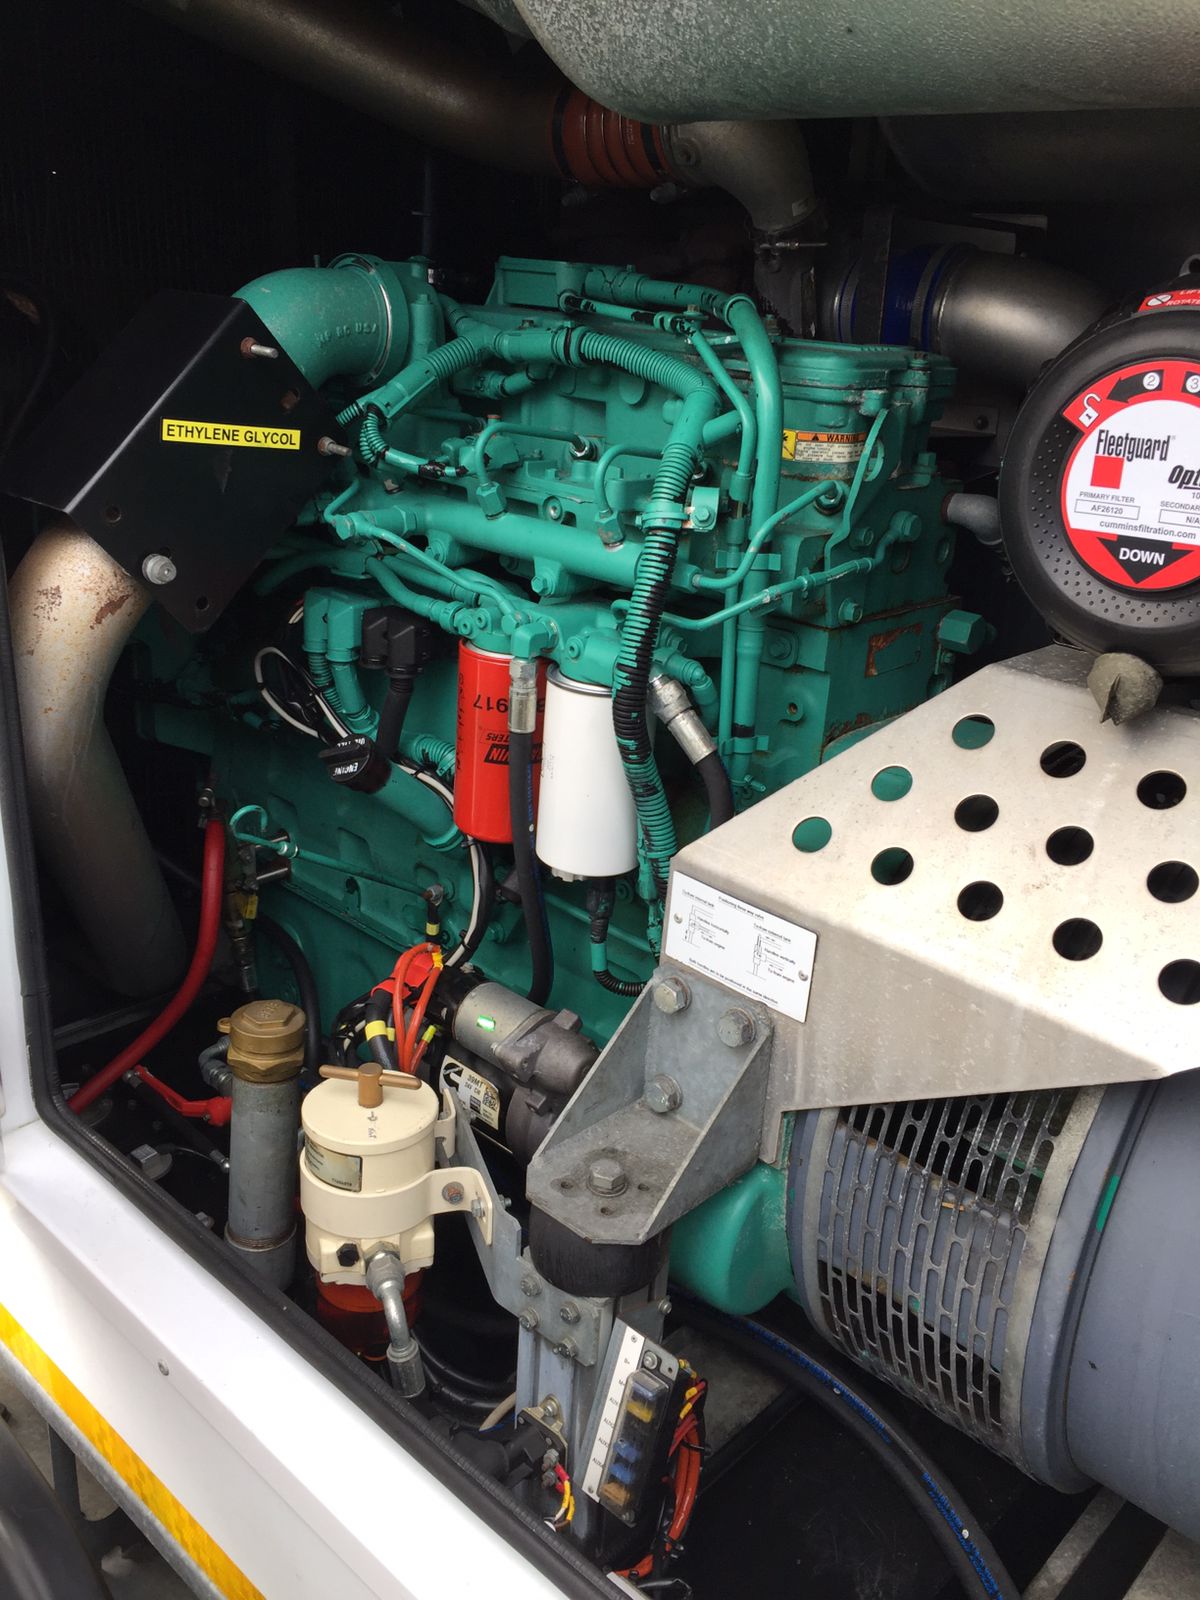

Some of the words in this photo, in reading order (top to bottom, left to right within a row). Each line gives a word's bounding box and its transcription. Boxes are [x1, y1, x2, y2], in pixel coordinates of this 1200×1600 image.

[166, 423, 240, 442] ETHYLENE
[243, 430, 296, 446] GLYCOL
[1095, 429, 1171, 462] Fleetguard
[1079, 490, 1110, 501] PRIMARY
[1111, 494, 1135, 503] FILTER
[1091, 504, 1123, 515] AF26120
[1099, 520, 1196, 540] cumminsfiltration.com
[1119, 547, 1165, 566] DOWN
